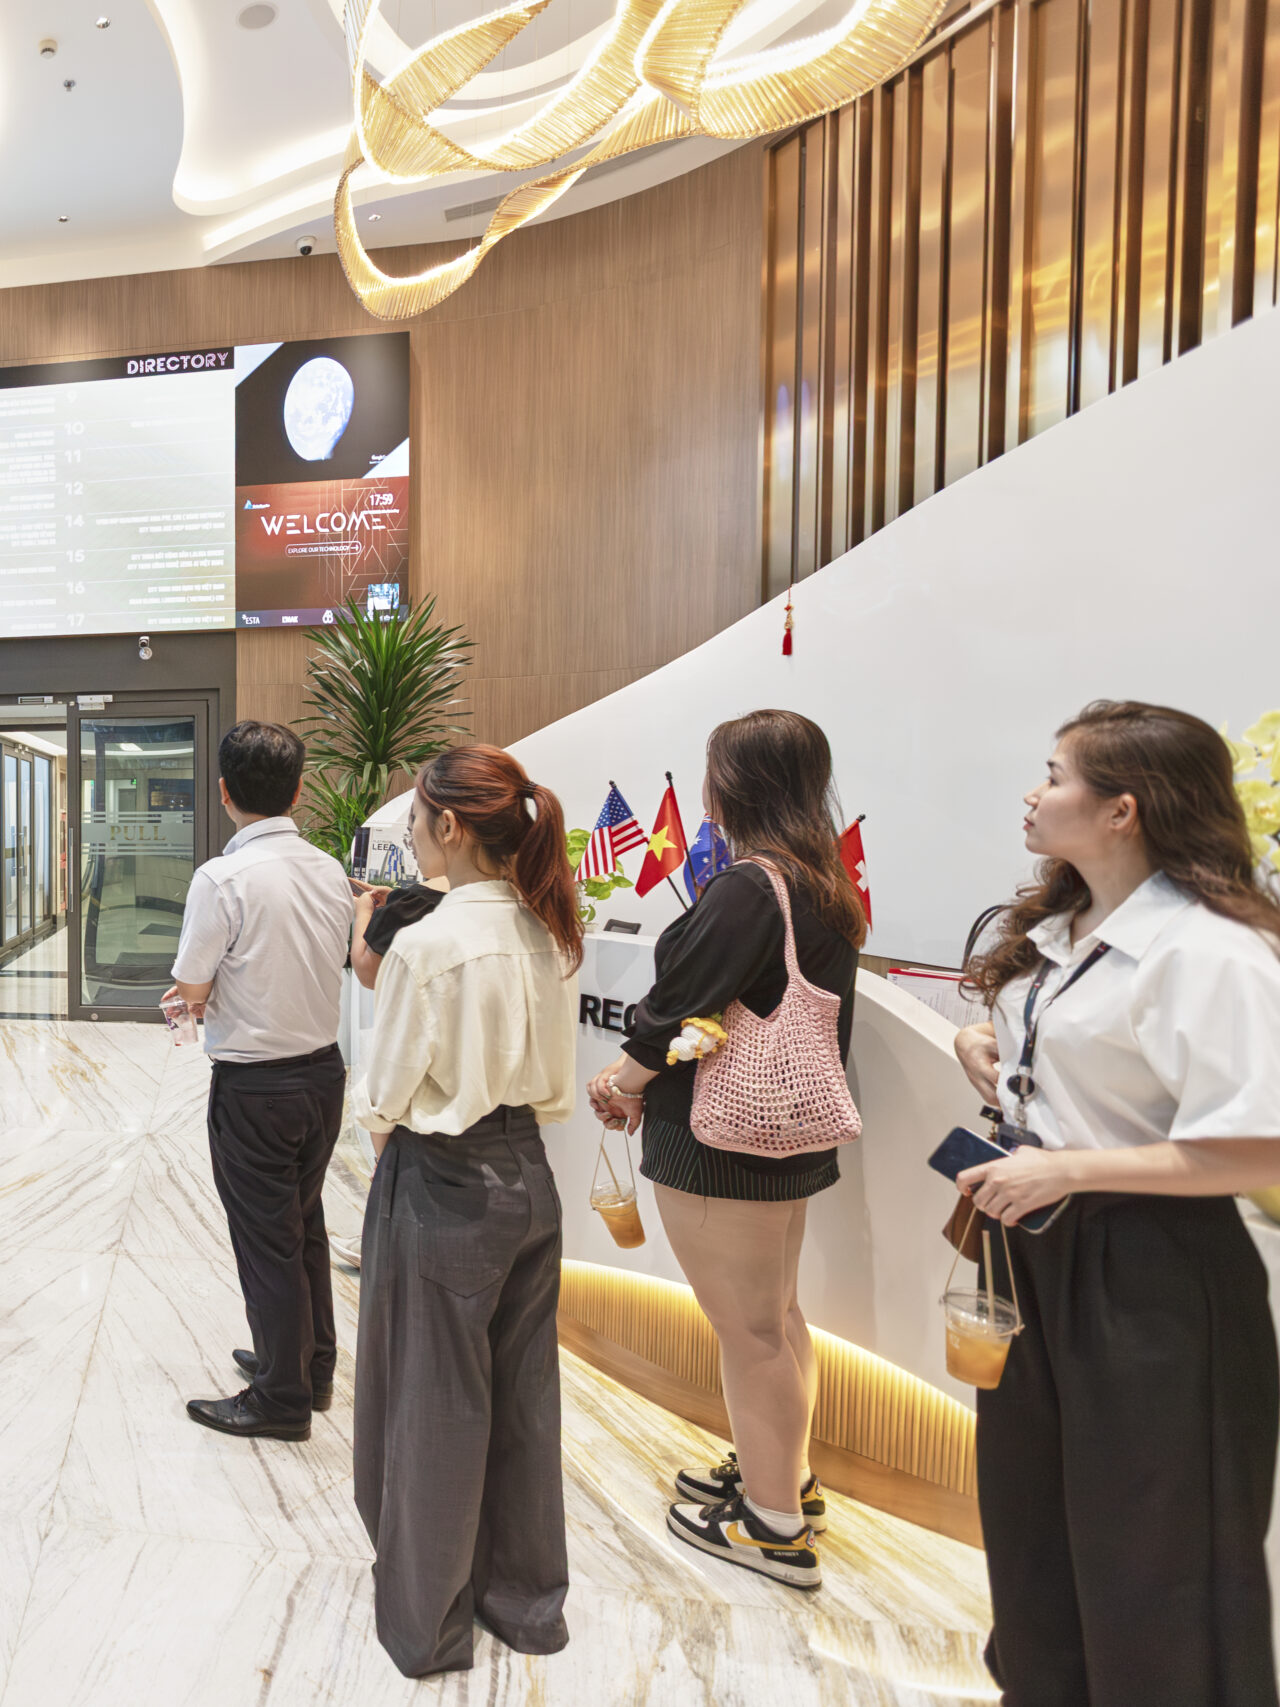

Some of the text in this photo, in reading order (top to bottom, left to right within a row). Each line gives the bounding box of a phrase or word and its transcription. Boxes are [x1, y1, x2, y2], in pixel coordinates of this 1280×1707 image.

[127, 352, 229, 375] DIRECTORY
[64, 422, 85, 435] 10
[64, 450, 82, 463] 11
[65, 482, 84, 496] 12
[65, 514, 85, 528] 14
[261, 509, 400, 536] WELCOME
[66, 550, 85, 562] 15
[66, 581, 85, 594] 16
[67, 613, 85, 626] 17
[110, 825, 167, 840] PULL
[372, 843, 397, 851] LEED
